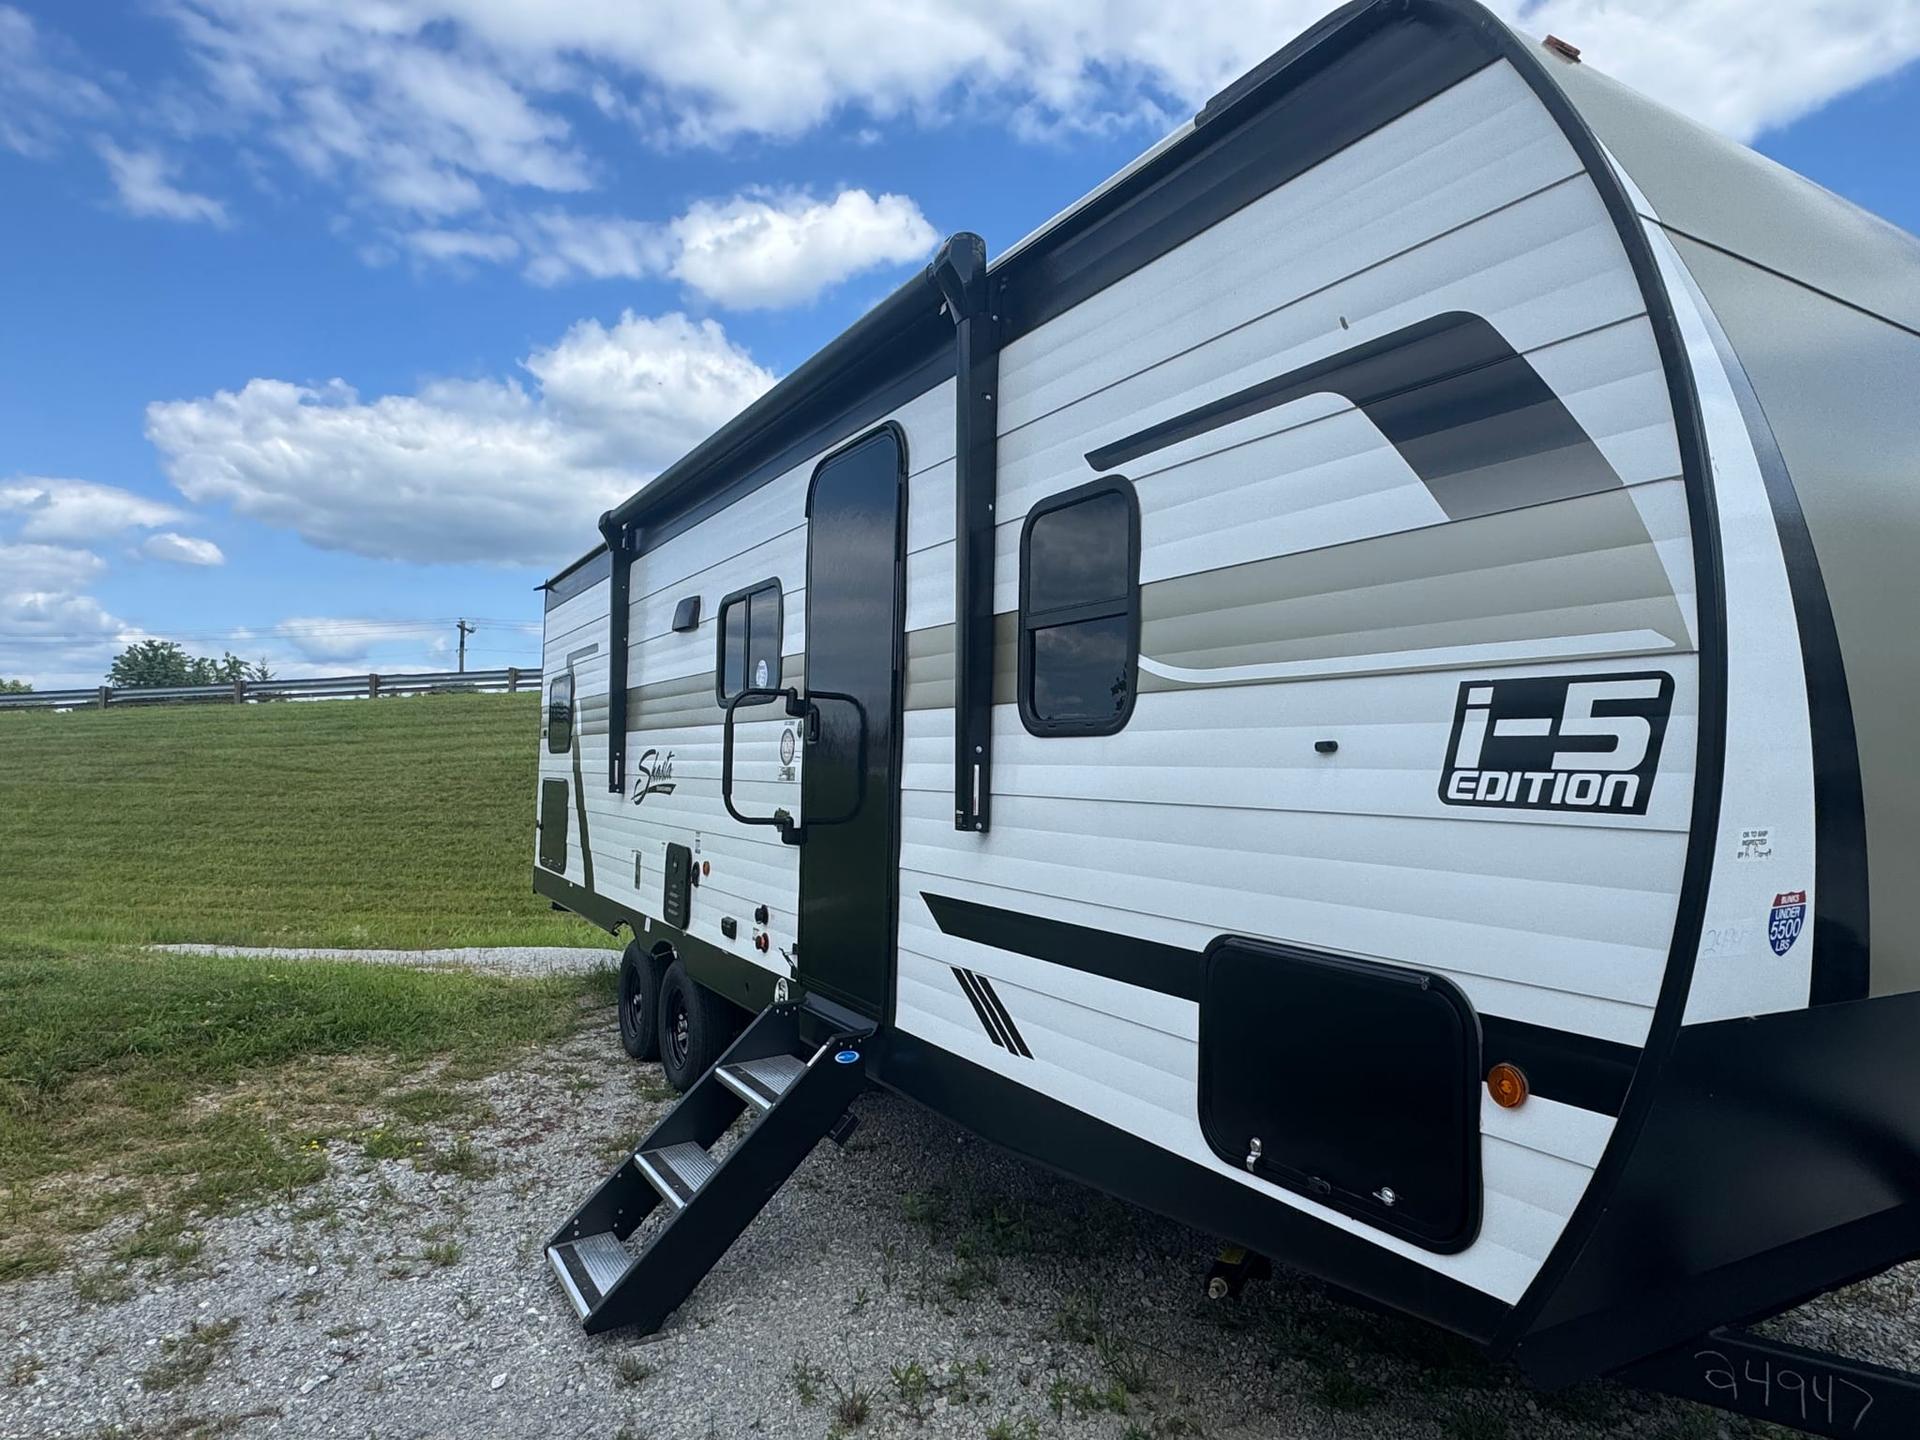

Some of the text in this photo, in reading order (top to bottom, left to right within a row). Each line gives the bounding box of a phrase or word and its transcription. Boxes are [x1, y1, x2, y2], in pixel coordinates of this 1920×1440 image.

[1454, 678, 1662, 772] i-5
[1447, 770, 1640, 808] EDITION
[1775, 906, 1801, 920] UNDER
[1769, 918, 1801, 941] 5500
[1775, 939, 1790, 952] LBS
[1694, 1350, 1874, 1431] 24947
